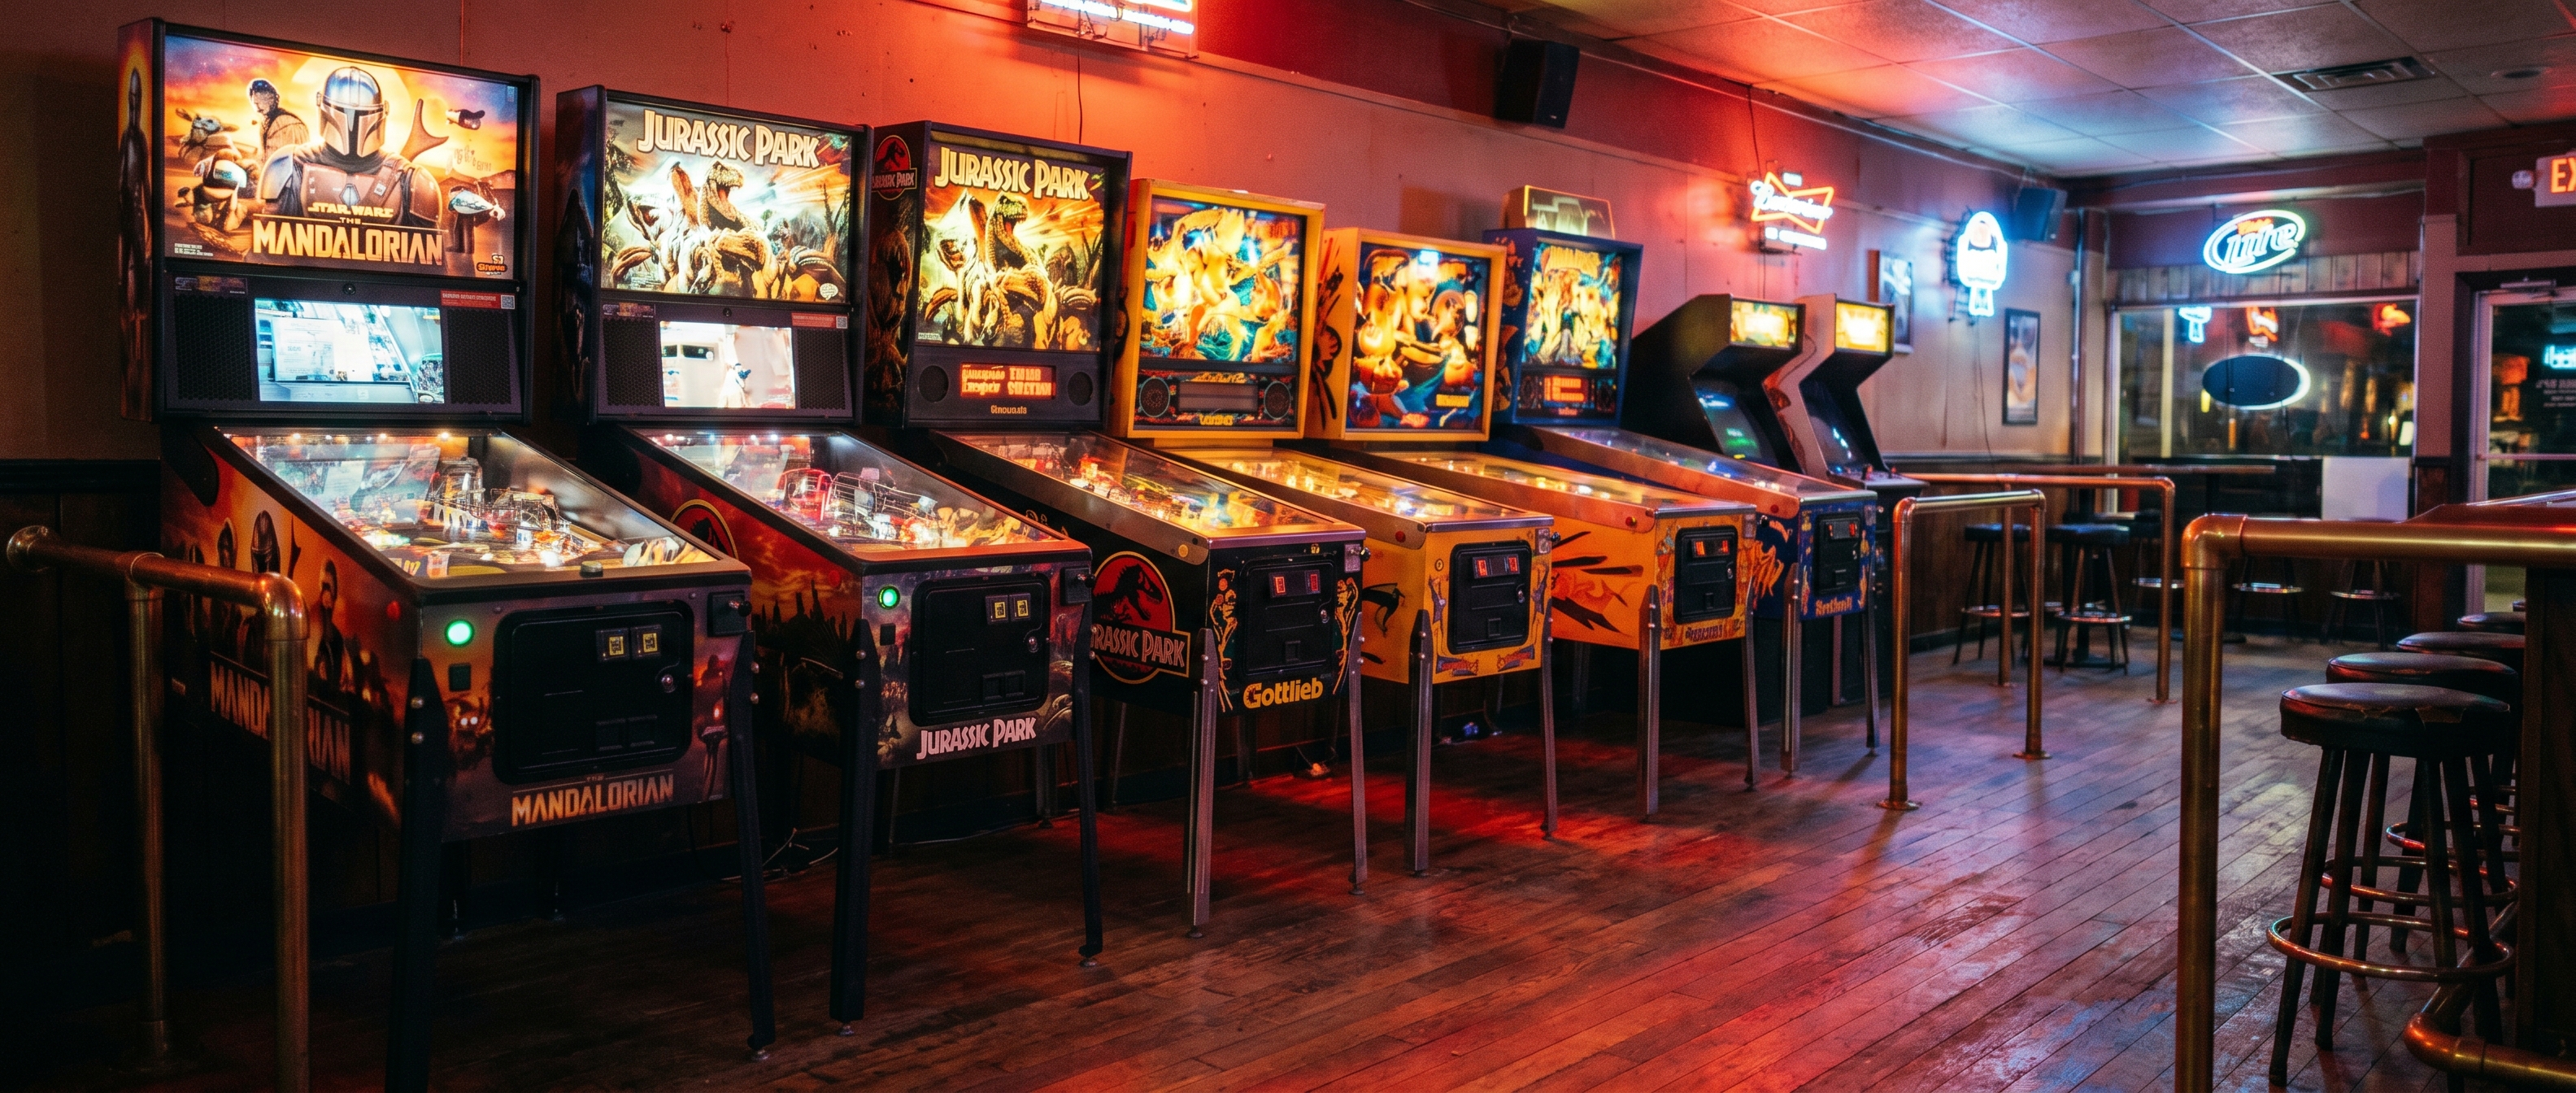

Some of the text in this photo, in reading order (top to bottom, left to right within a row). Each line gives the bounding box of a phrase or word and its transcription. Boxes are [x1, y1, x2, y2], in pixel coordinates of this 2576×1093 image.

[637, 109, 820, 168] JURASSIC PARK
[935, 146, 1090, 201] JURASSIC PARK
[307, 202, 351, 216] STAR
[339, 216, 362, 224] THE
[253, 220, 442, 266] MANDALORIAN
[1090, 624, 1186, 668] RASSIC PARK
[1243, 677, 1324, 709] Gottlieb
[916, 716, 1037, 760] JURASSIC PARK
[511, 774, 674, 827] MANDALORIAN
